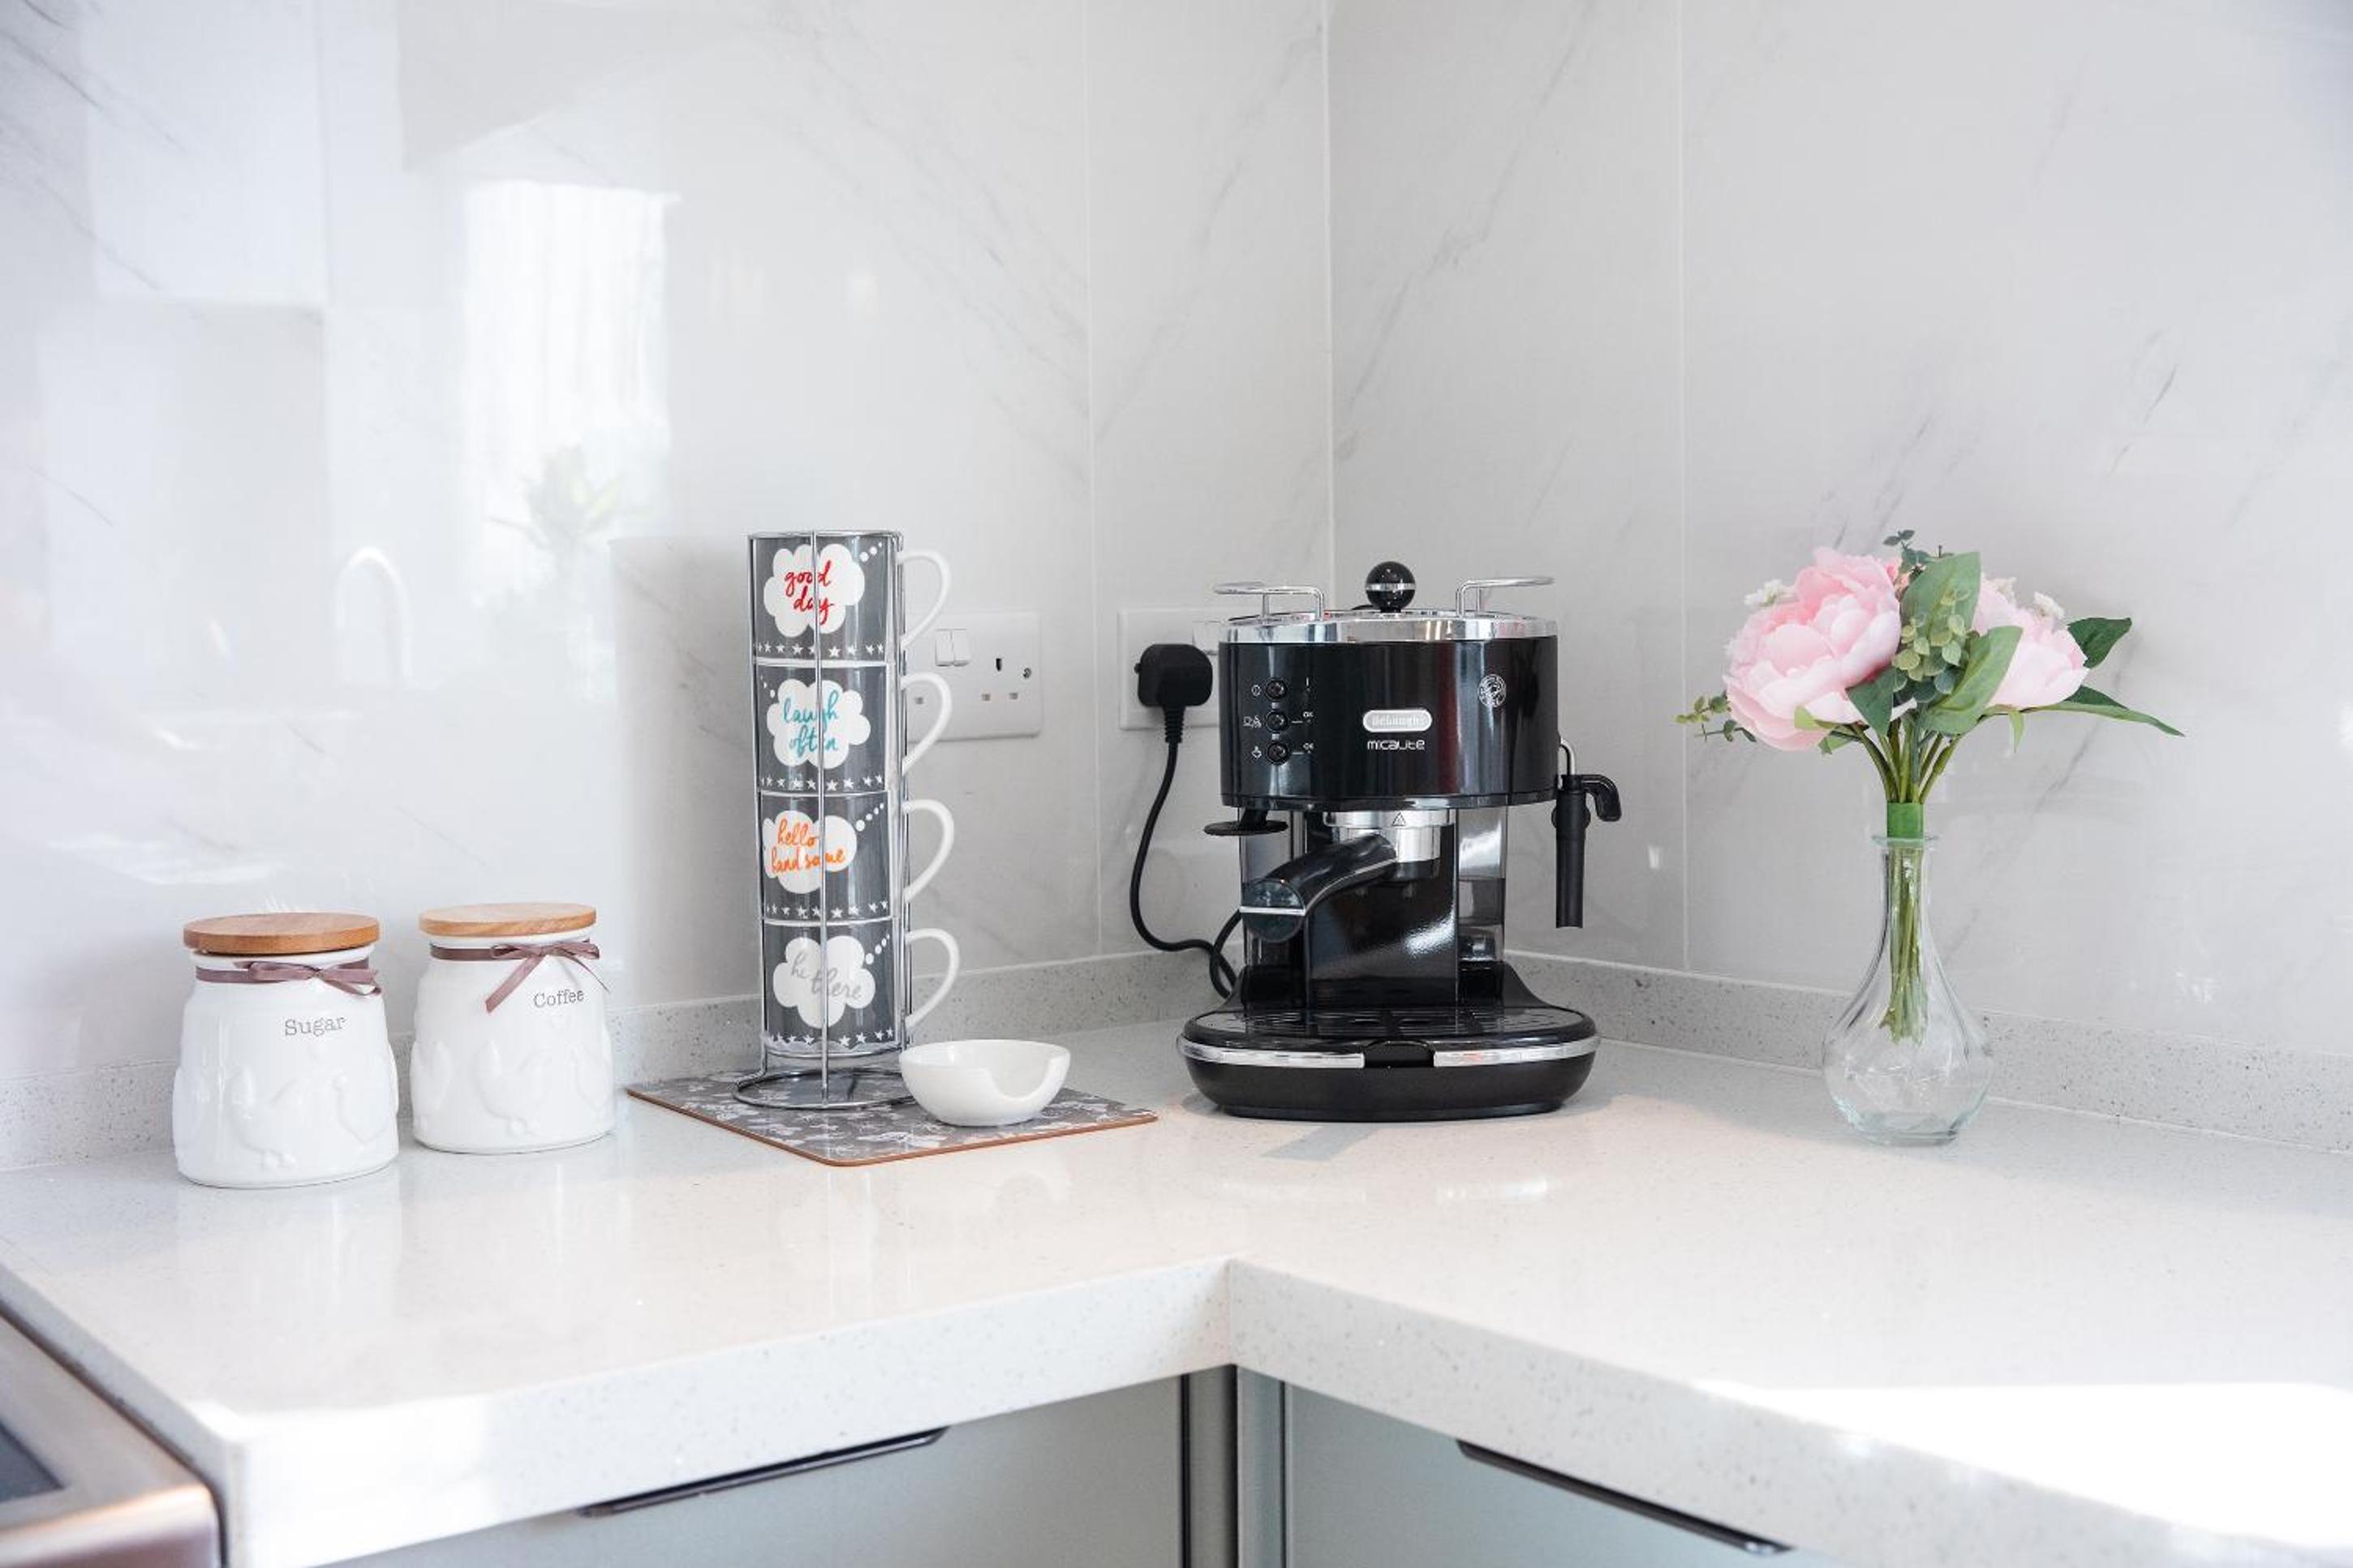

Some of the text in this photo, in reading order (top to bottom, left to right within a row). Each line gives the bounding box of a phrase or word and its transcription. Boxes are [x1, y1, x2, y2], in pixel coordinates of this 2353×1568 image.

[784, 560, 831, 598] good
[794, 585, 835, 625] day
[788, 724, 839, 758] oftn
[777, 818, 819, 848] hello
[790, 951, 812, 979] hi
[533, 989, 584, 1008] Coffee
[285, 1016, 346, 1037] Sugar
